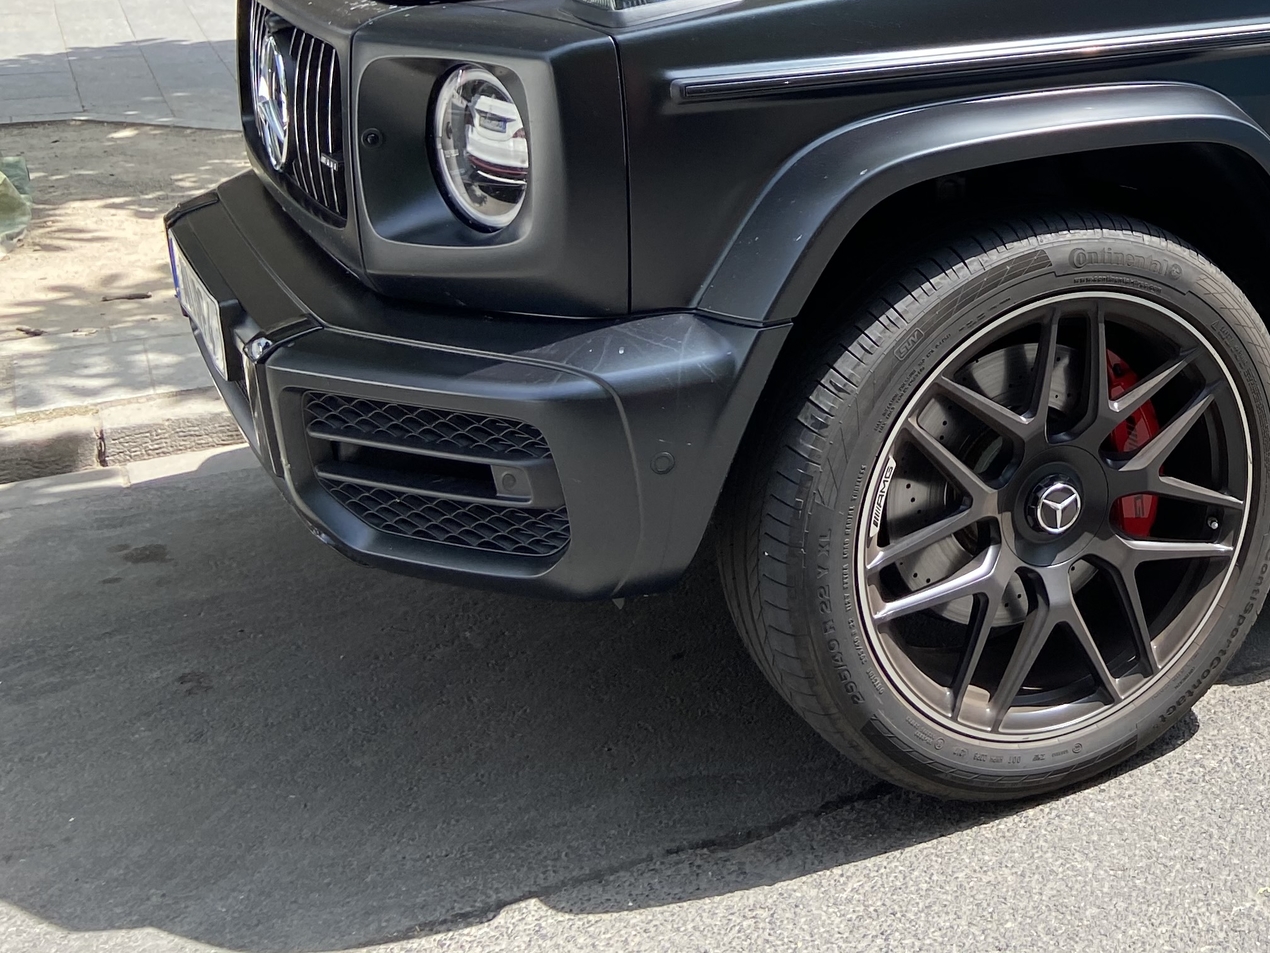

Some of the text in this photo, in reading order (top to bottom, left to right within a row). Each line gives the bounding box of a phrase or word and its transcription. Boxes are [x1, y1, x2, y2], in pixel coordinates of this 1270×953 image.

[1068, 246, 1169, 277] Continental
[897, 329, 922, 358] SUV
[874, 466, 894, 514] AMG
